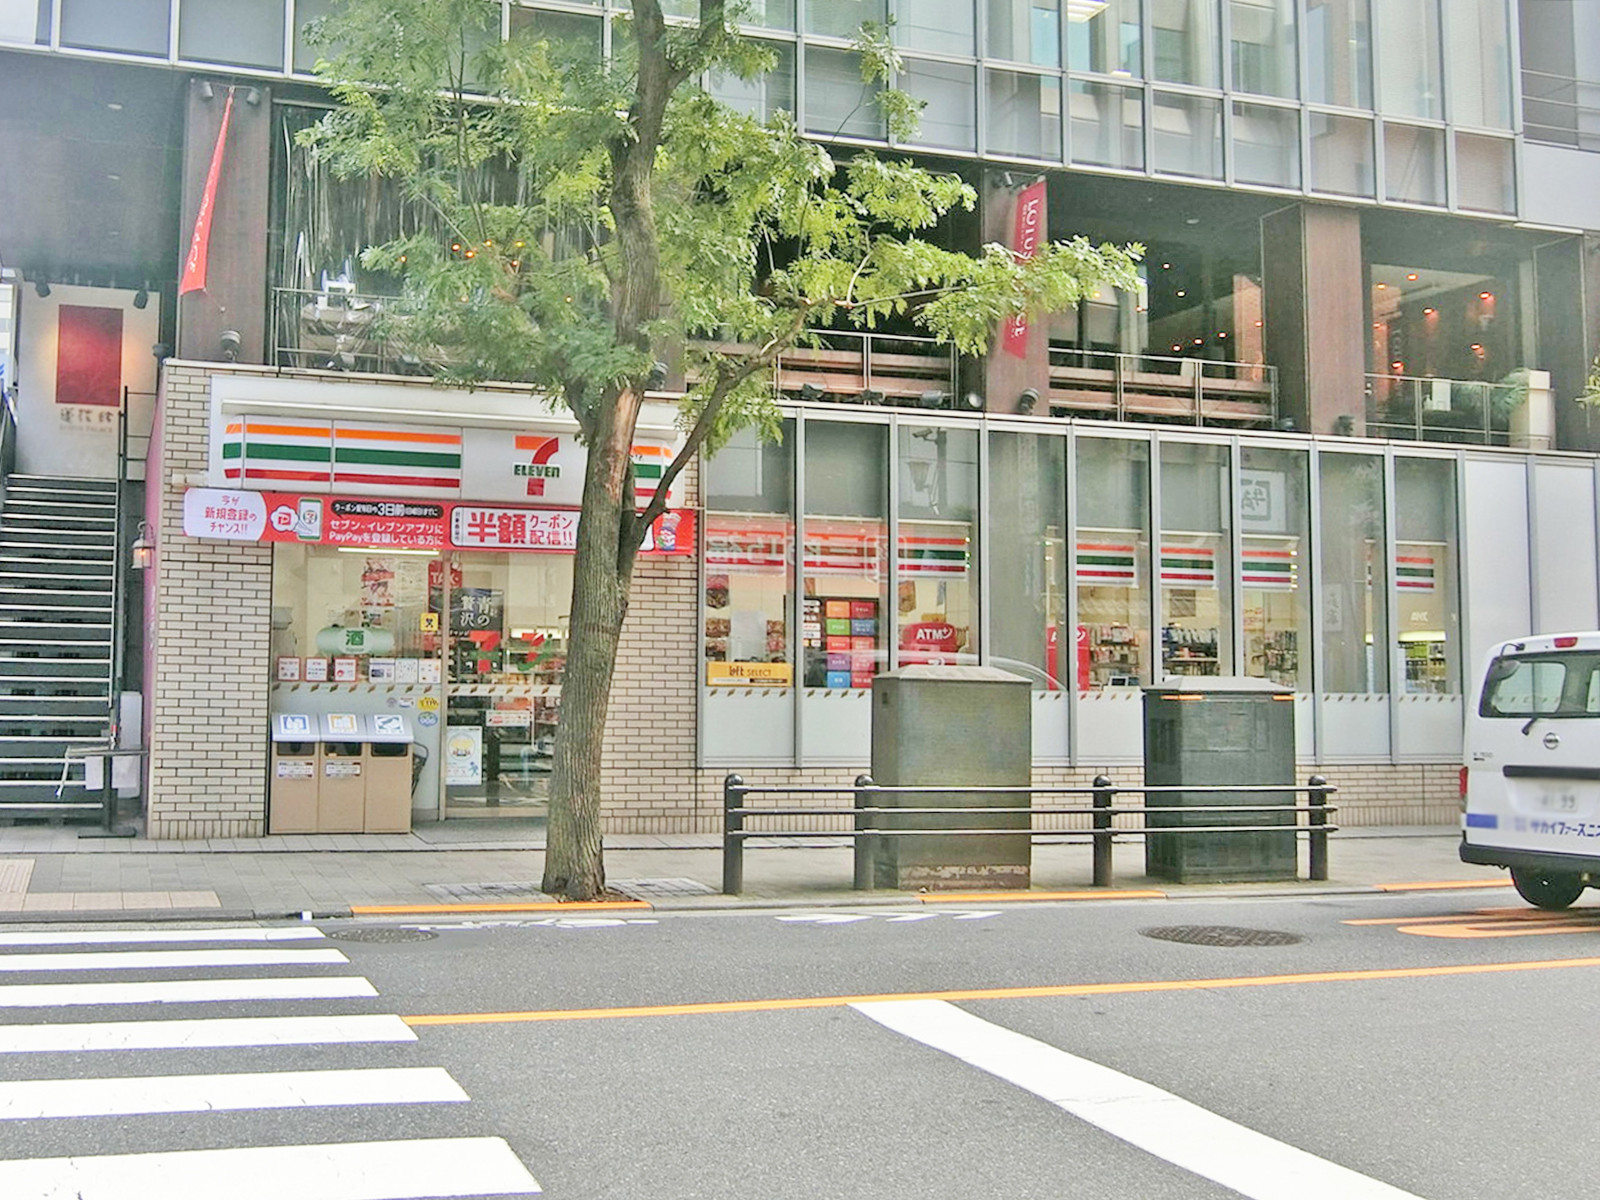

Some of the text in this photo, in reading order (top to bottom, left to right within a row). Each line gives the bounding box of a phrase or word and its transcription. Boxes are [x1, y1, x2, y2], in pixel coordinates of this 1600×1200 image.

[204, 507, 257, 522] 新規登録の
[529, 514, 573, 528] クーポン
[467, 512, 526, 544] 半額
[345, 630, 364, 646] 酒
[916, 628, 943, 640] ATM
[746, 668, 772, 677] SELECT
